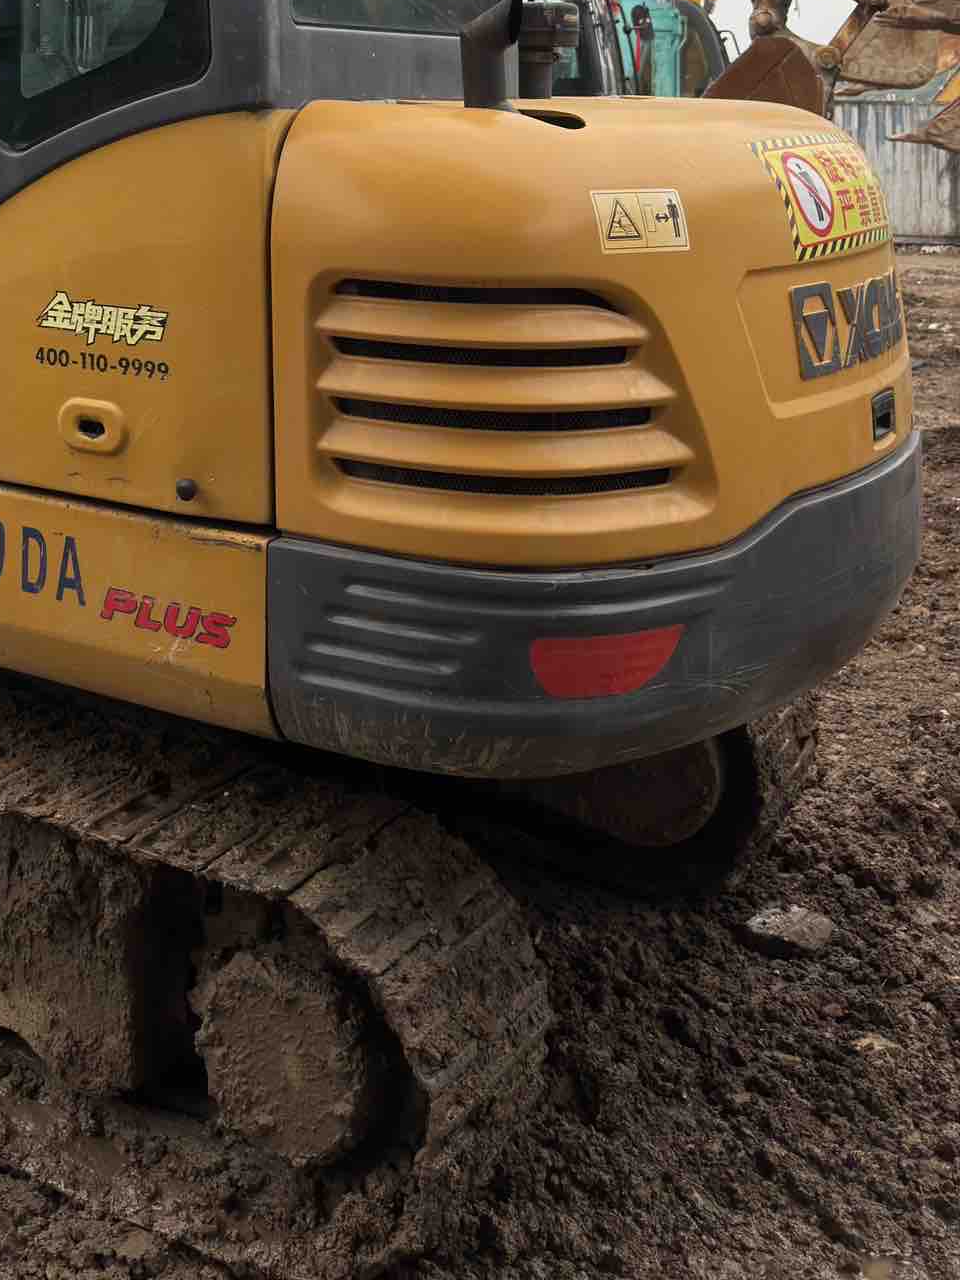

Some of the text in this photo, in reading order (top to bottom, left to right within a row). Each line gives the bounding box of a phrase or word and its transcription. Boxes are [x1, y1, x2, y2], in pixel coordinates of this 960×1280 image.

[37, 291, 169, 345] 金牌服务
[35, 347, 169, 381] 400-110-9999
[100, 586, 237, 649] PLUS
